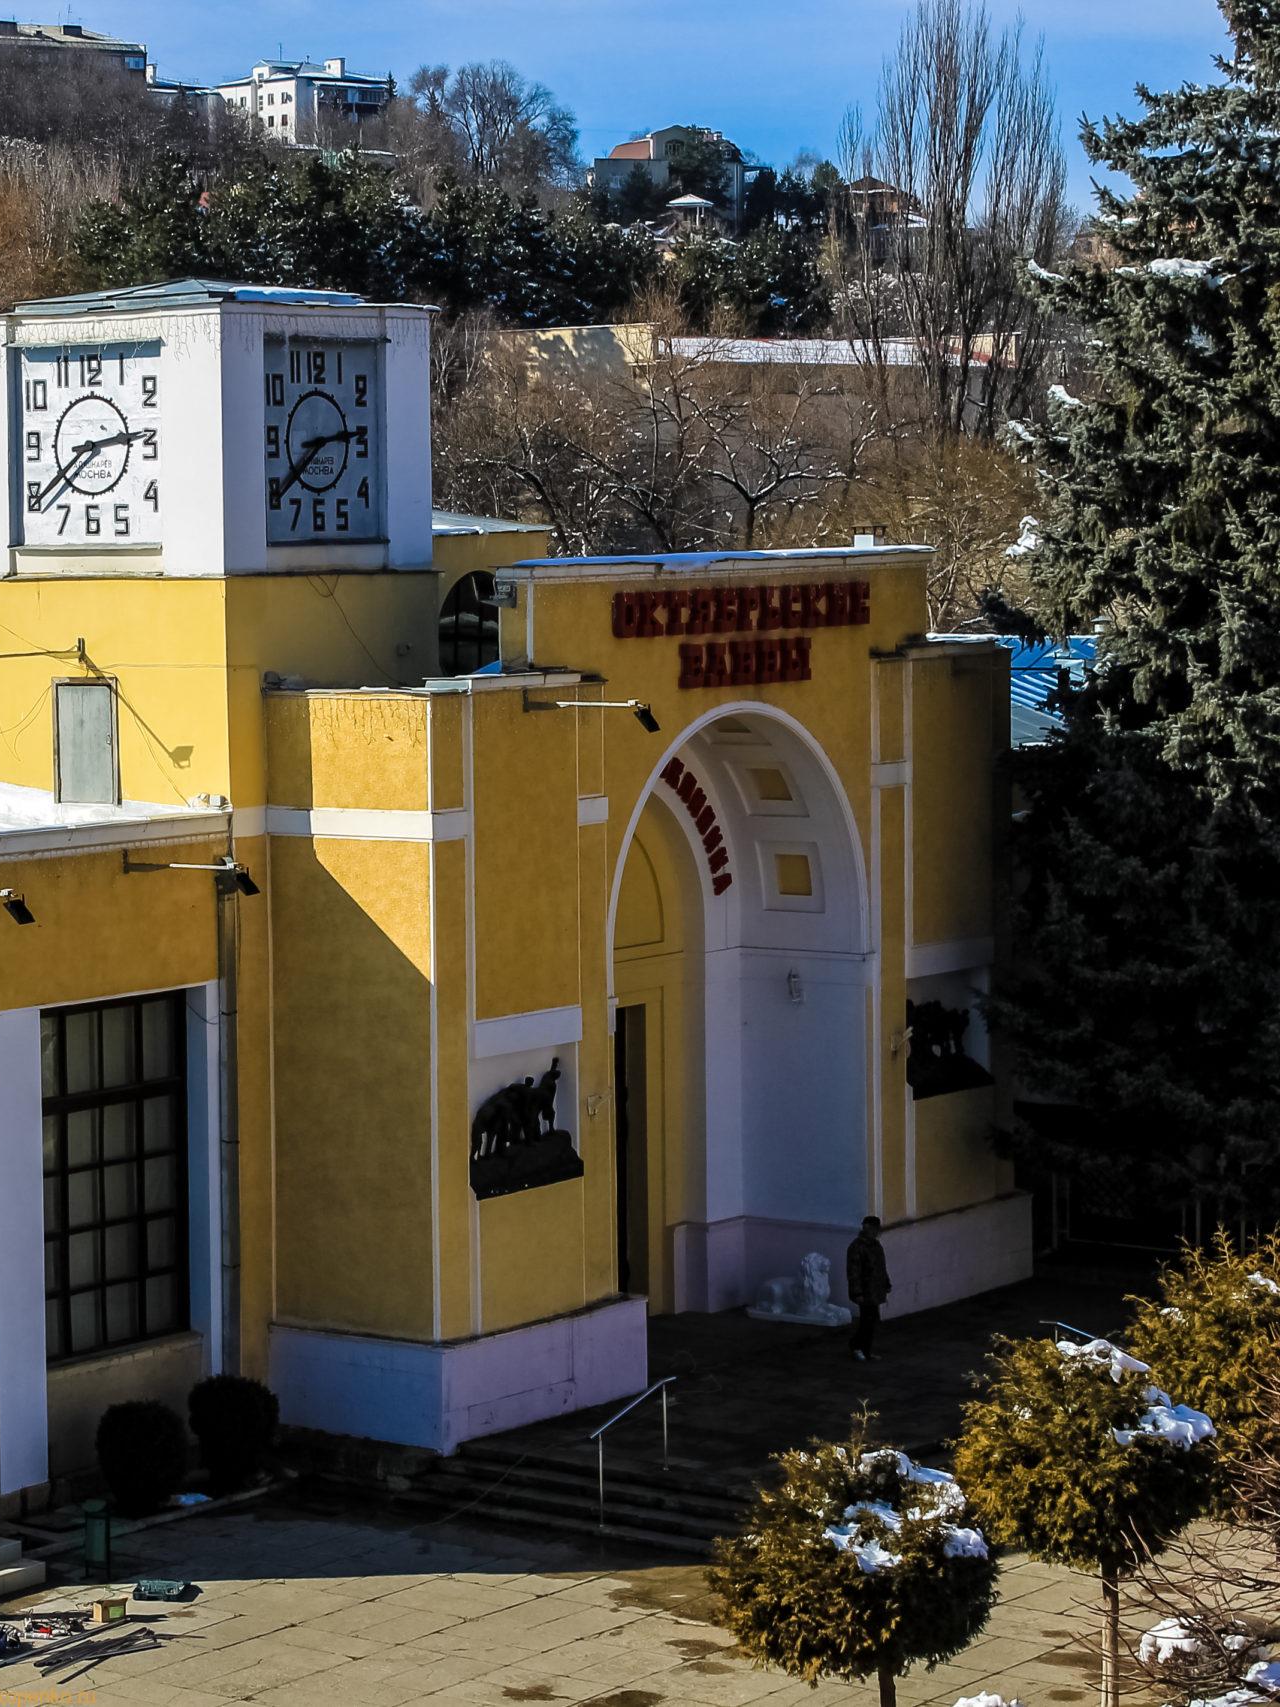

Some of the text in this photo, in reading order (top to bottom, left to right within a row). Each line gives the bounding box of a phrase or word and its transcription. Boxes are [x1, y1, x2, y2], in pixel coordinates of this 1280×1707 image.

[56, 354, 69, 388] 11
[80, 354, 102, 387] 12
[119, 353, 124, 385] 1
[290, 351, 301, 384] 11
[307, 351, 326, 384] 12
[337, 352, 342, 384] 1
[25, 379, 47, 412] 10
[142, 375, 157, 408] 2
[266, 373, 285, 407] 10
[355, 374, 367, 407] 2
[27, 432, 41, 462] 9
[142, 428, 158, 460] 3
[267, 425, 280, 458] 9
[356, 426, 368, 458] 3
[28, 481, 41, 513] 8
[143, 479, 158, 512] 4
[268, 477, 281, 510] 8
[357, 476, 369, 509] 4
[56, 504, 71, 536] 7
[85, 504, 101, 536] 6
[113, 503, 129, 536] 5
[289, 498, 302, 531] 7
[312, 499, 325, 531] 6
[336, 499, 349, 531] 5
[612, 582, 870, 638] ОКТЯБРЬСКИЕ
[678, 637, 812, 689] ВАННЫ
